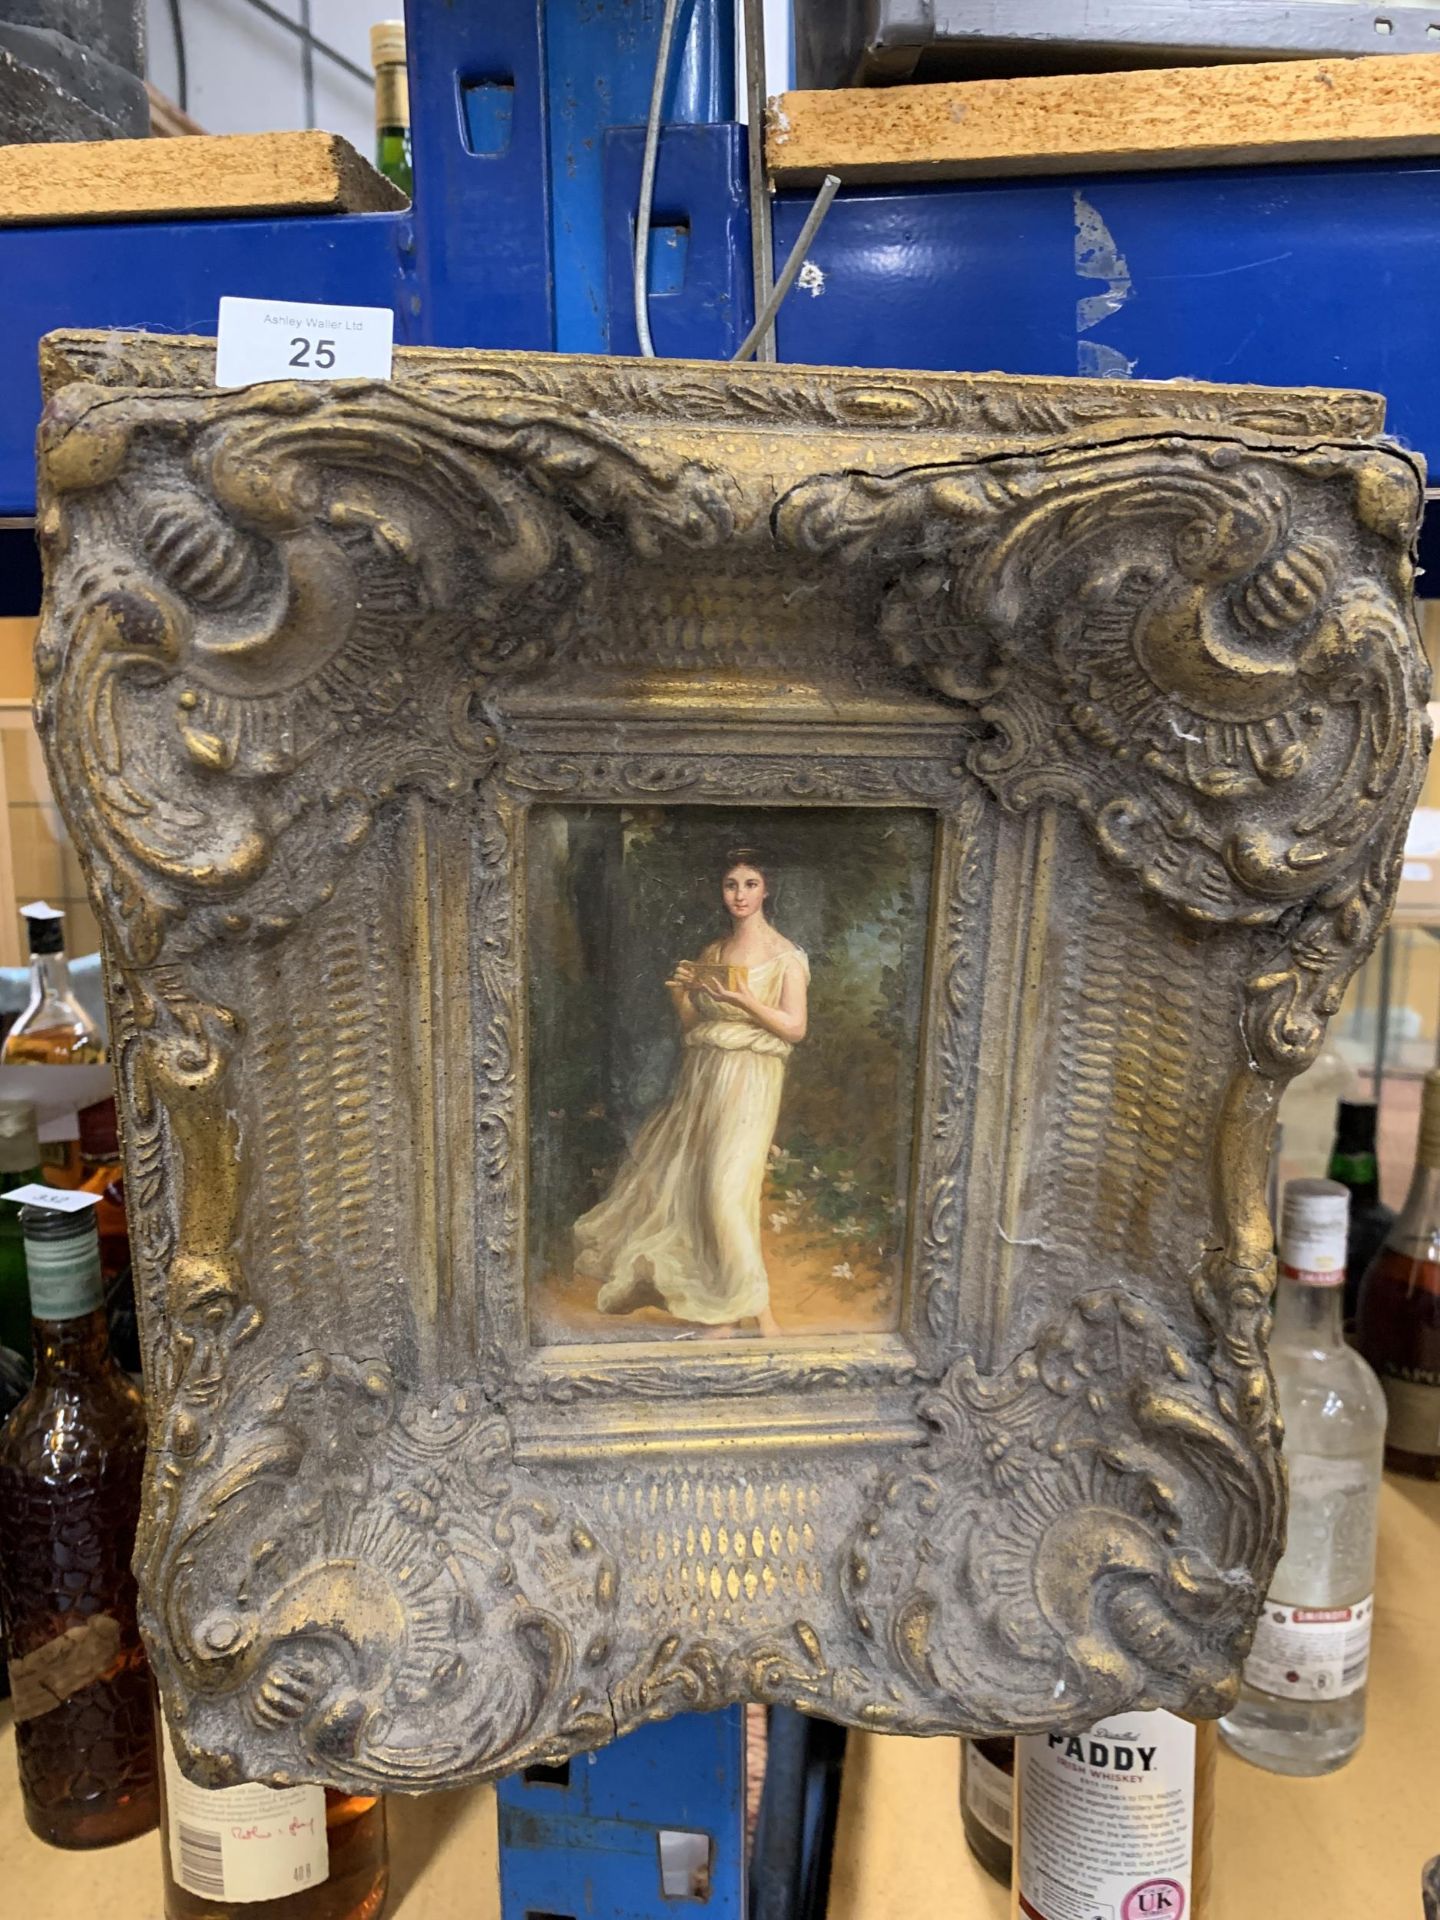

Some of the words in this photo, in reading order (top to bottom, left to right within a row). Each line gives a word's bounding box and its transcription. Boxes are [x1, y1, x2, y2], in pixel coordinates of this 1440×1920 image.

[263, 313, 302, 329] Ashley
[306, 317, 342, 330] Waller
[346, 319, 364, 331] Ltd
[288, 337, 336, 369] 25
[1056, 1755, 1087, 1775] IRISH
[1090, 1769, 1145, 1783] WHISKEY
[1137, 1891, 1173, 1912] UK
